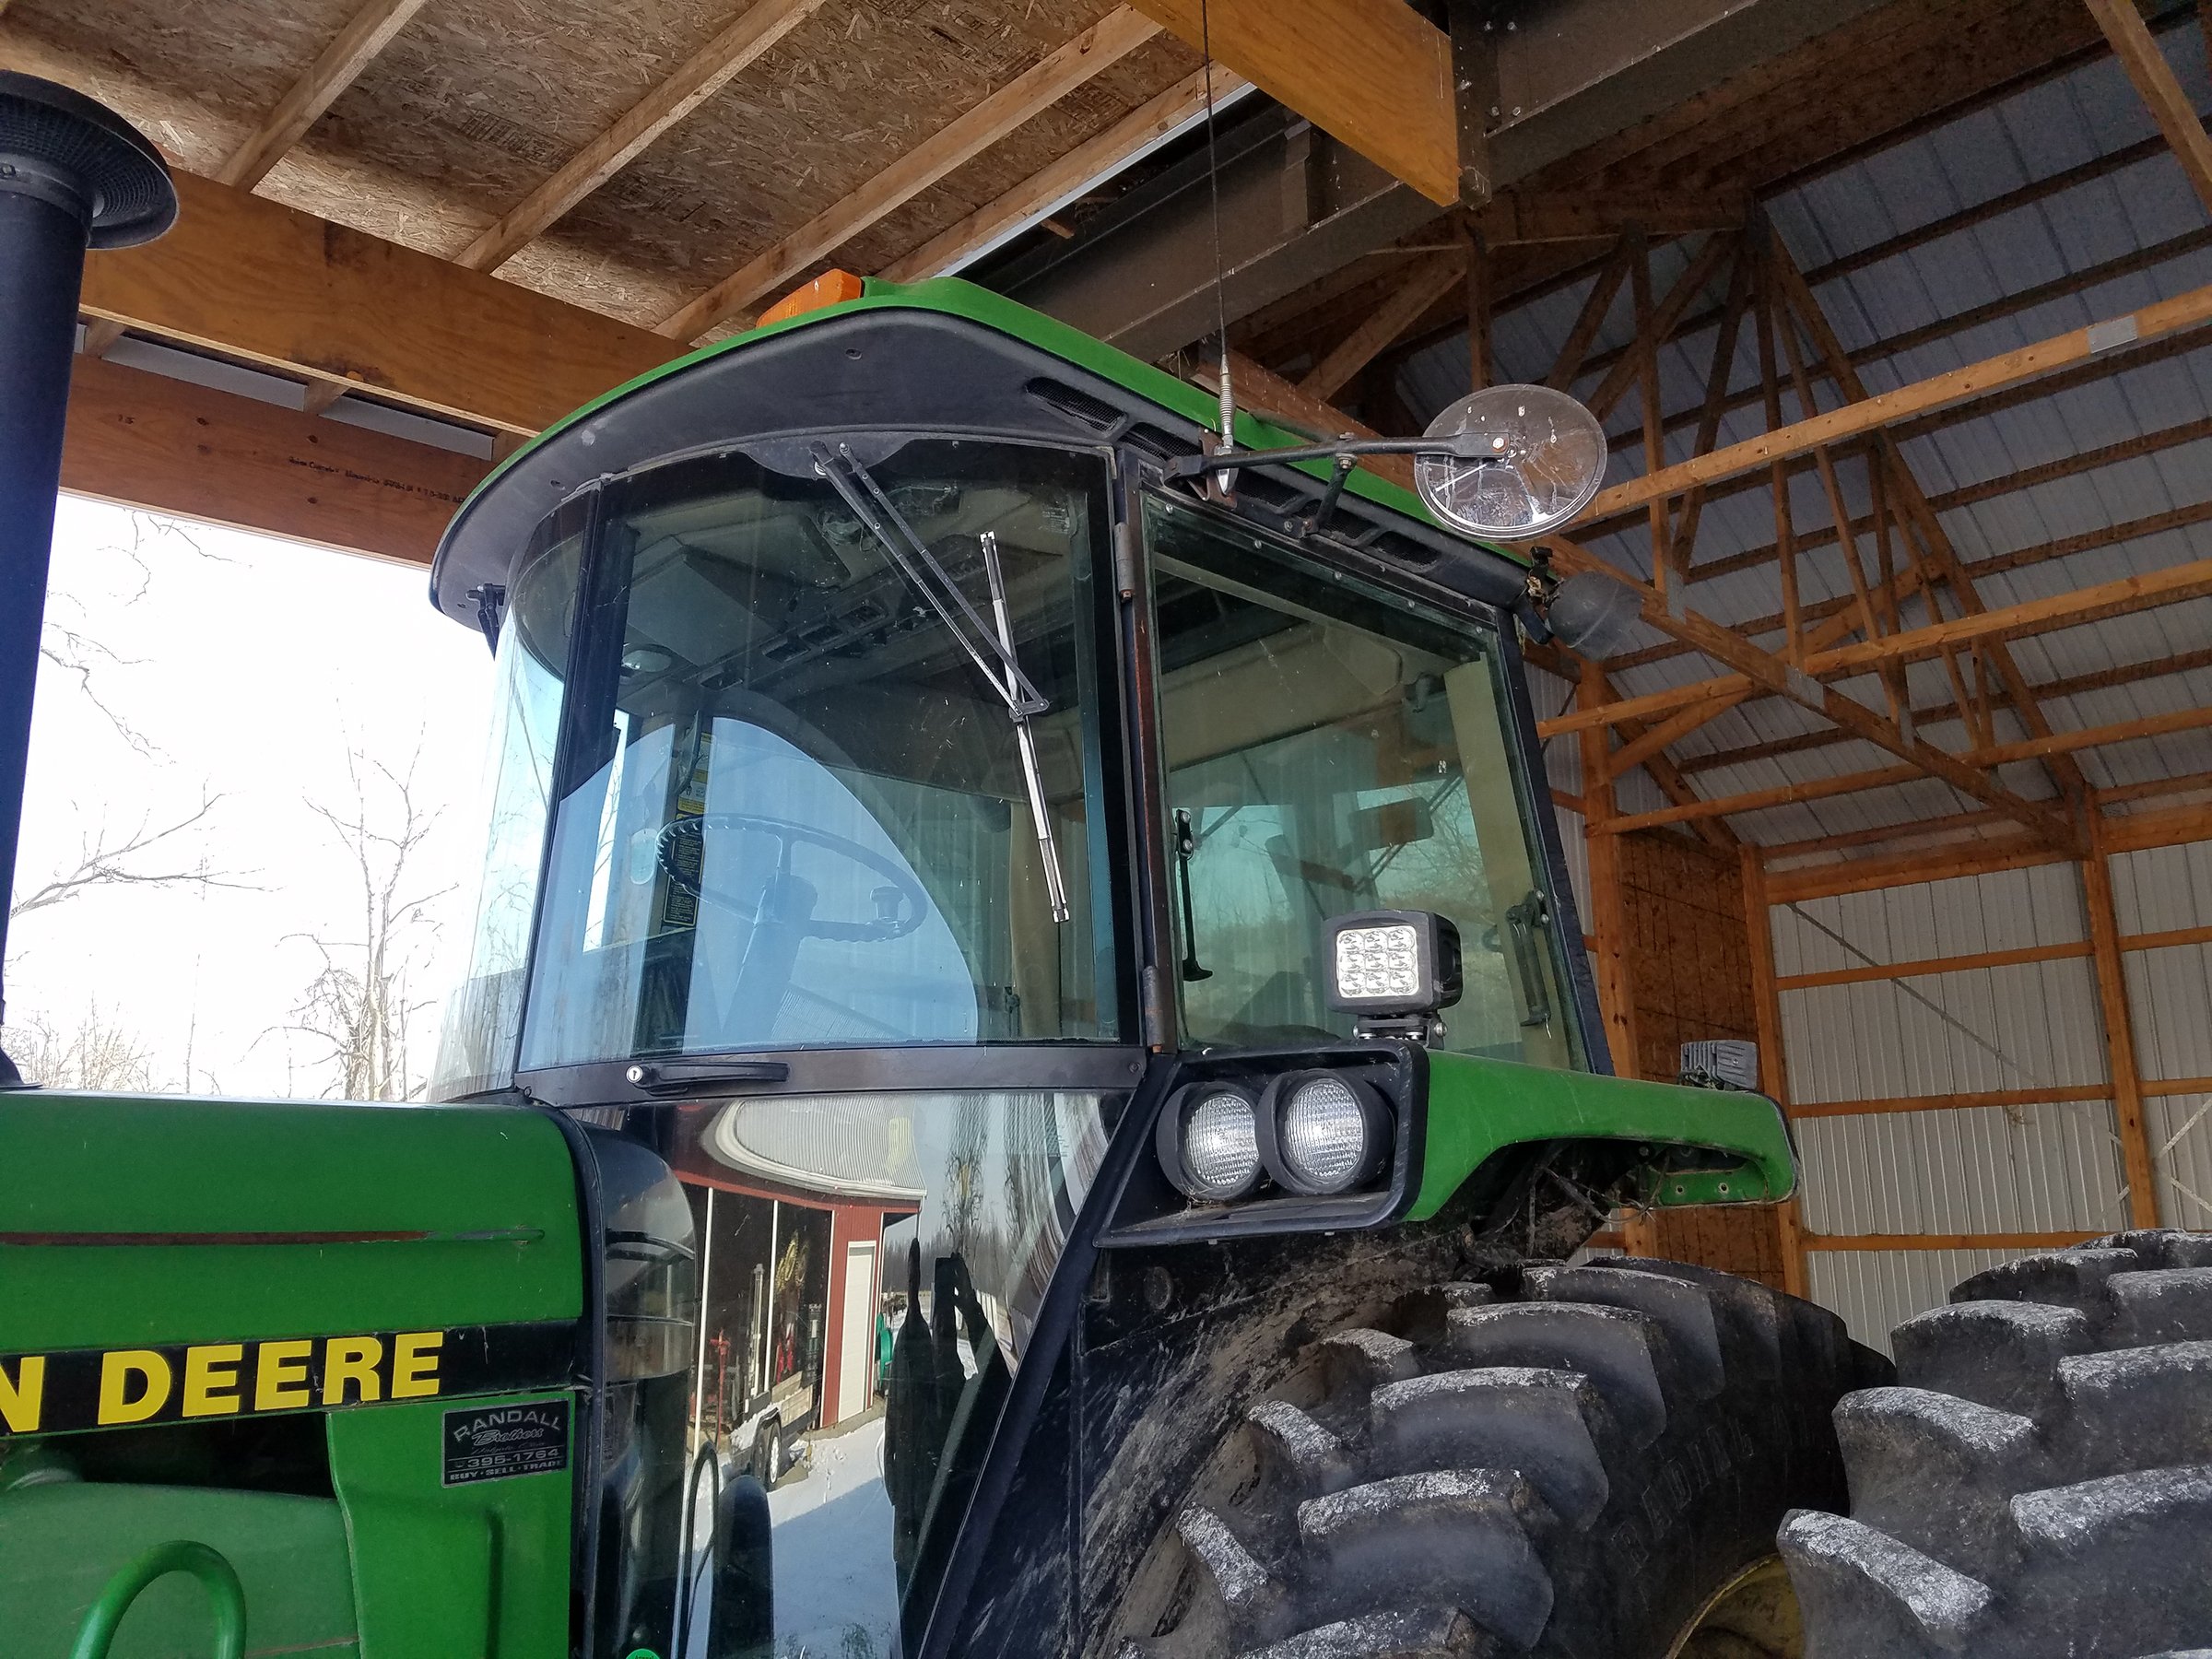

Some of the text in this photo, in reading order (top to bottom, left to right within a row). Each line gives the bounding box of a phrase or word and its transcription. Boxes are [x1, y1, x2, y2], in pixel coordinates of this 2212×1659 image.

[98, 1332, 443, 1425] DEERE
[453, 1410, 560, 1441] RANDALL
[471, 1428, 545, 1446] Brothers
[467, 1448, 559, 1468] 395-1764
[450, 1471, 478, 1480] BUY
[486, 1466, 516, 1476] SELL
